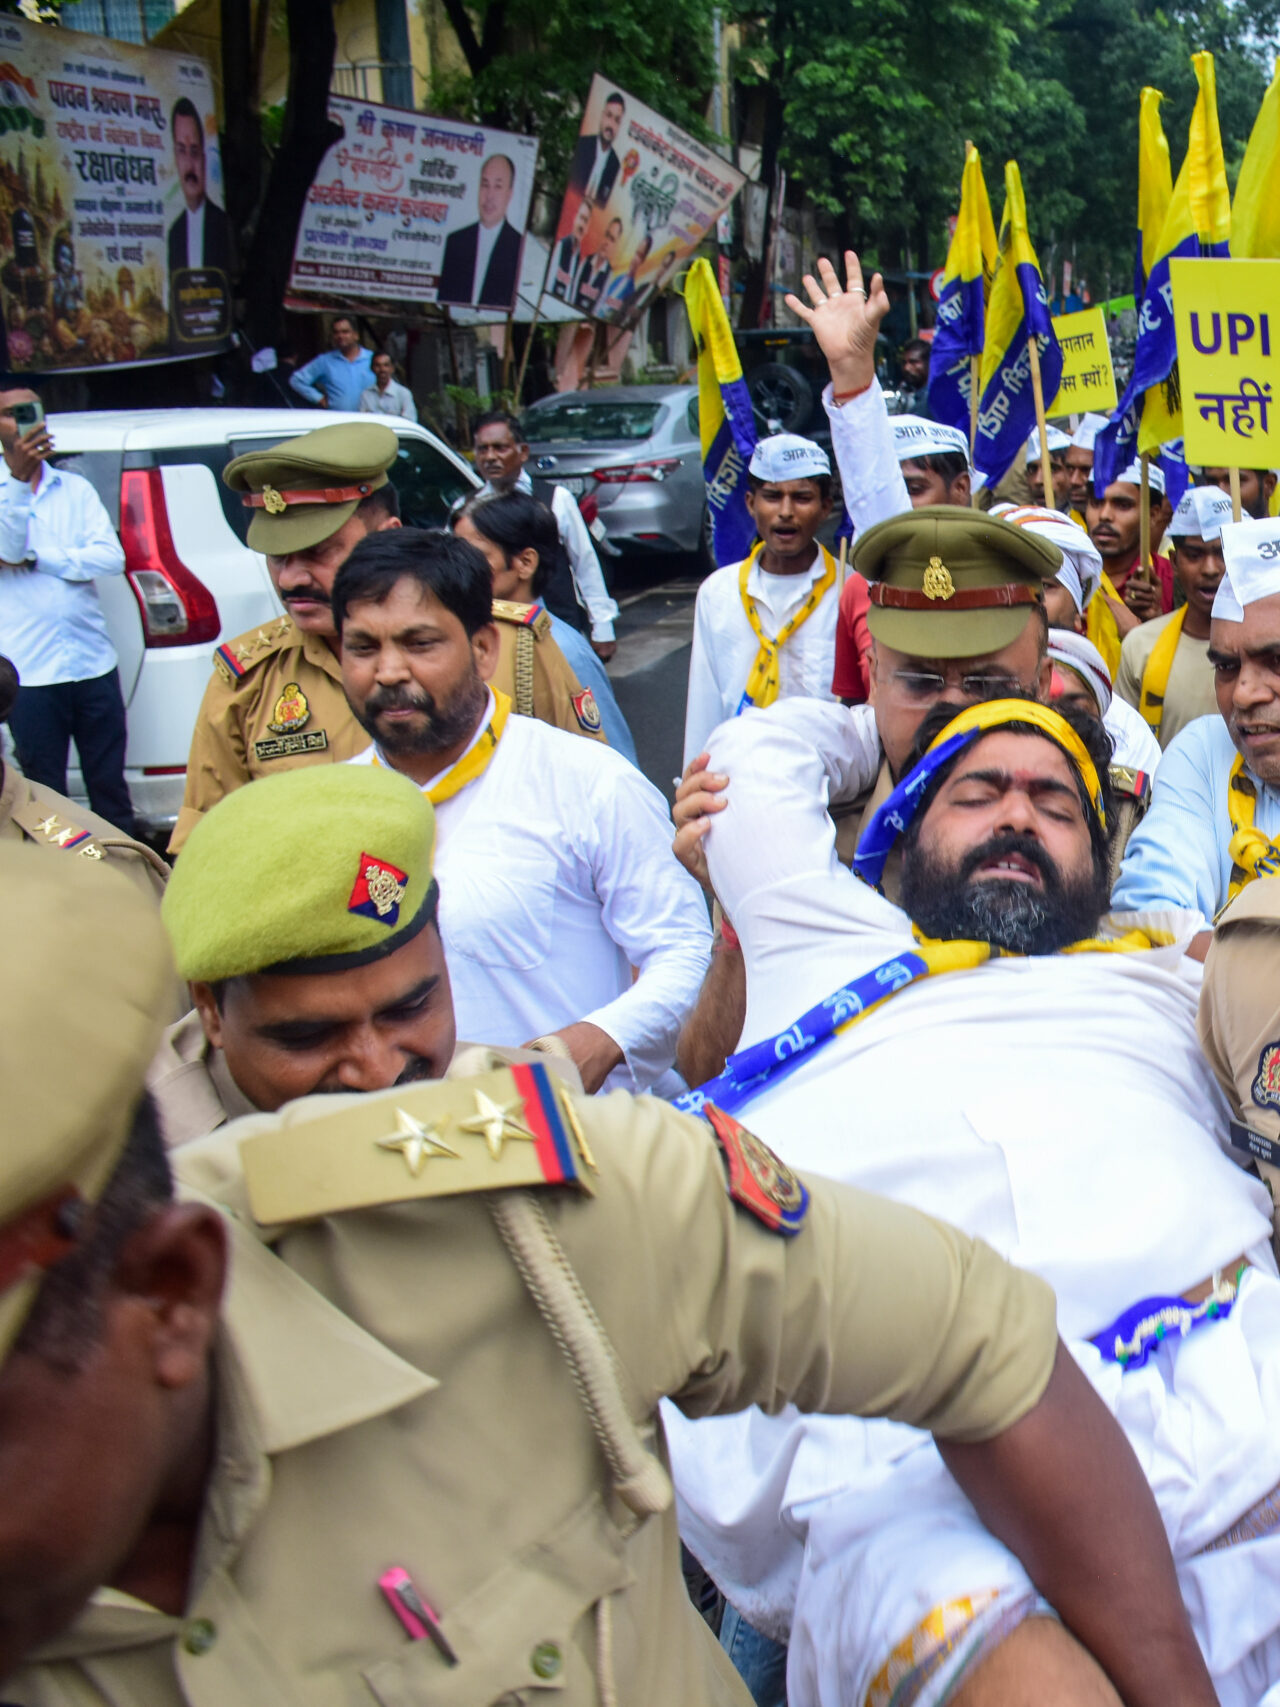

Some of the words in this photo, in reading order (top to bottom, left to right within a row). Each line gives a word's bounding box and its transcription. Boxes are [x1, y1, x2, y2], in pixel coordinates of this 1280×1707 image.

[48, 80, 88, 111] पावन
[74, 147, 157, 186] रक्षाबंधन
[1190, 311, 1271, 357] UPI
[1194, 377, 1273, 438] नहीं
